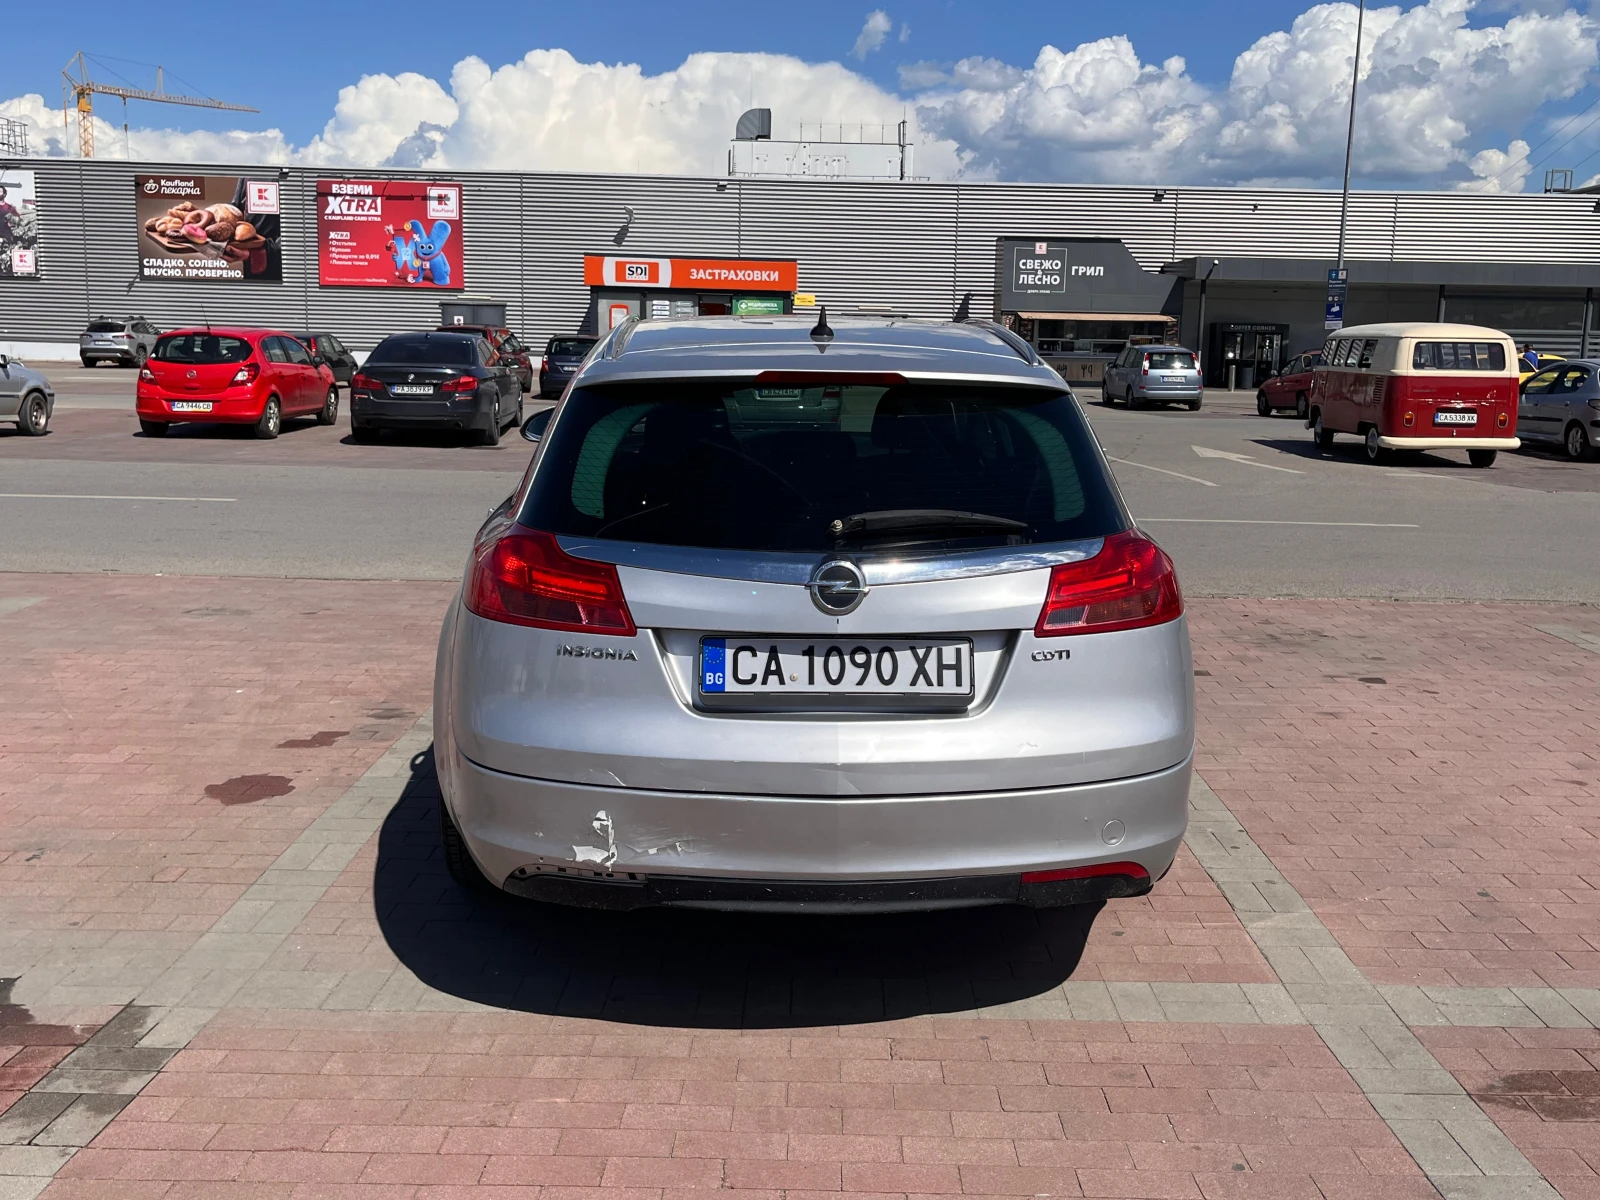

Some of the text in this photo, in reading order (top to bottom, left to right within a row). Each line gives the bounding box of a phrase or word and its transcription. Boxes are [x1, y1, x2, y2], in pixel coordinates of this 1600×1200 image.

[161, 179, 194, 187] Kaufland
[161, 187, 201, 197] пекарна
[332, 184, 373, 195] ВЗЕМИ
[325, 196, 381, 215] XTRA
[329, 231, 350, 239] XTRA
[143, 258, 229, 268] СЛАДКО. СОЛЕНО.
[1019, 259, 1061, 270] СВЕЖО
[143, 268, 244, 278] ВКУСНО. ПРОВЕРЕНО.
[627, 265, 647, 276] SDI
[689, 268, 779, 281] ЗАСТРАХОВКИ
[1071, 266, 1104, 276] ГРИЛ
[1018, 275, 1060, 285] ЛЕСНО
[556, 644, 638, 661] INSIGNIA
[1031, 649, 1071, 661] CDTI
[732, 645, 963, 687] CA 1090 XH
[705, 672, 723, 685] BG
